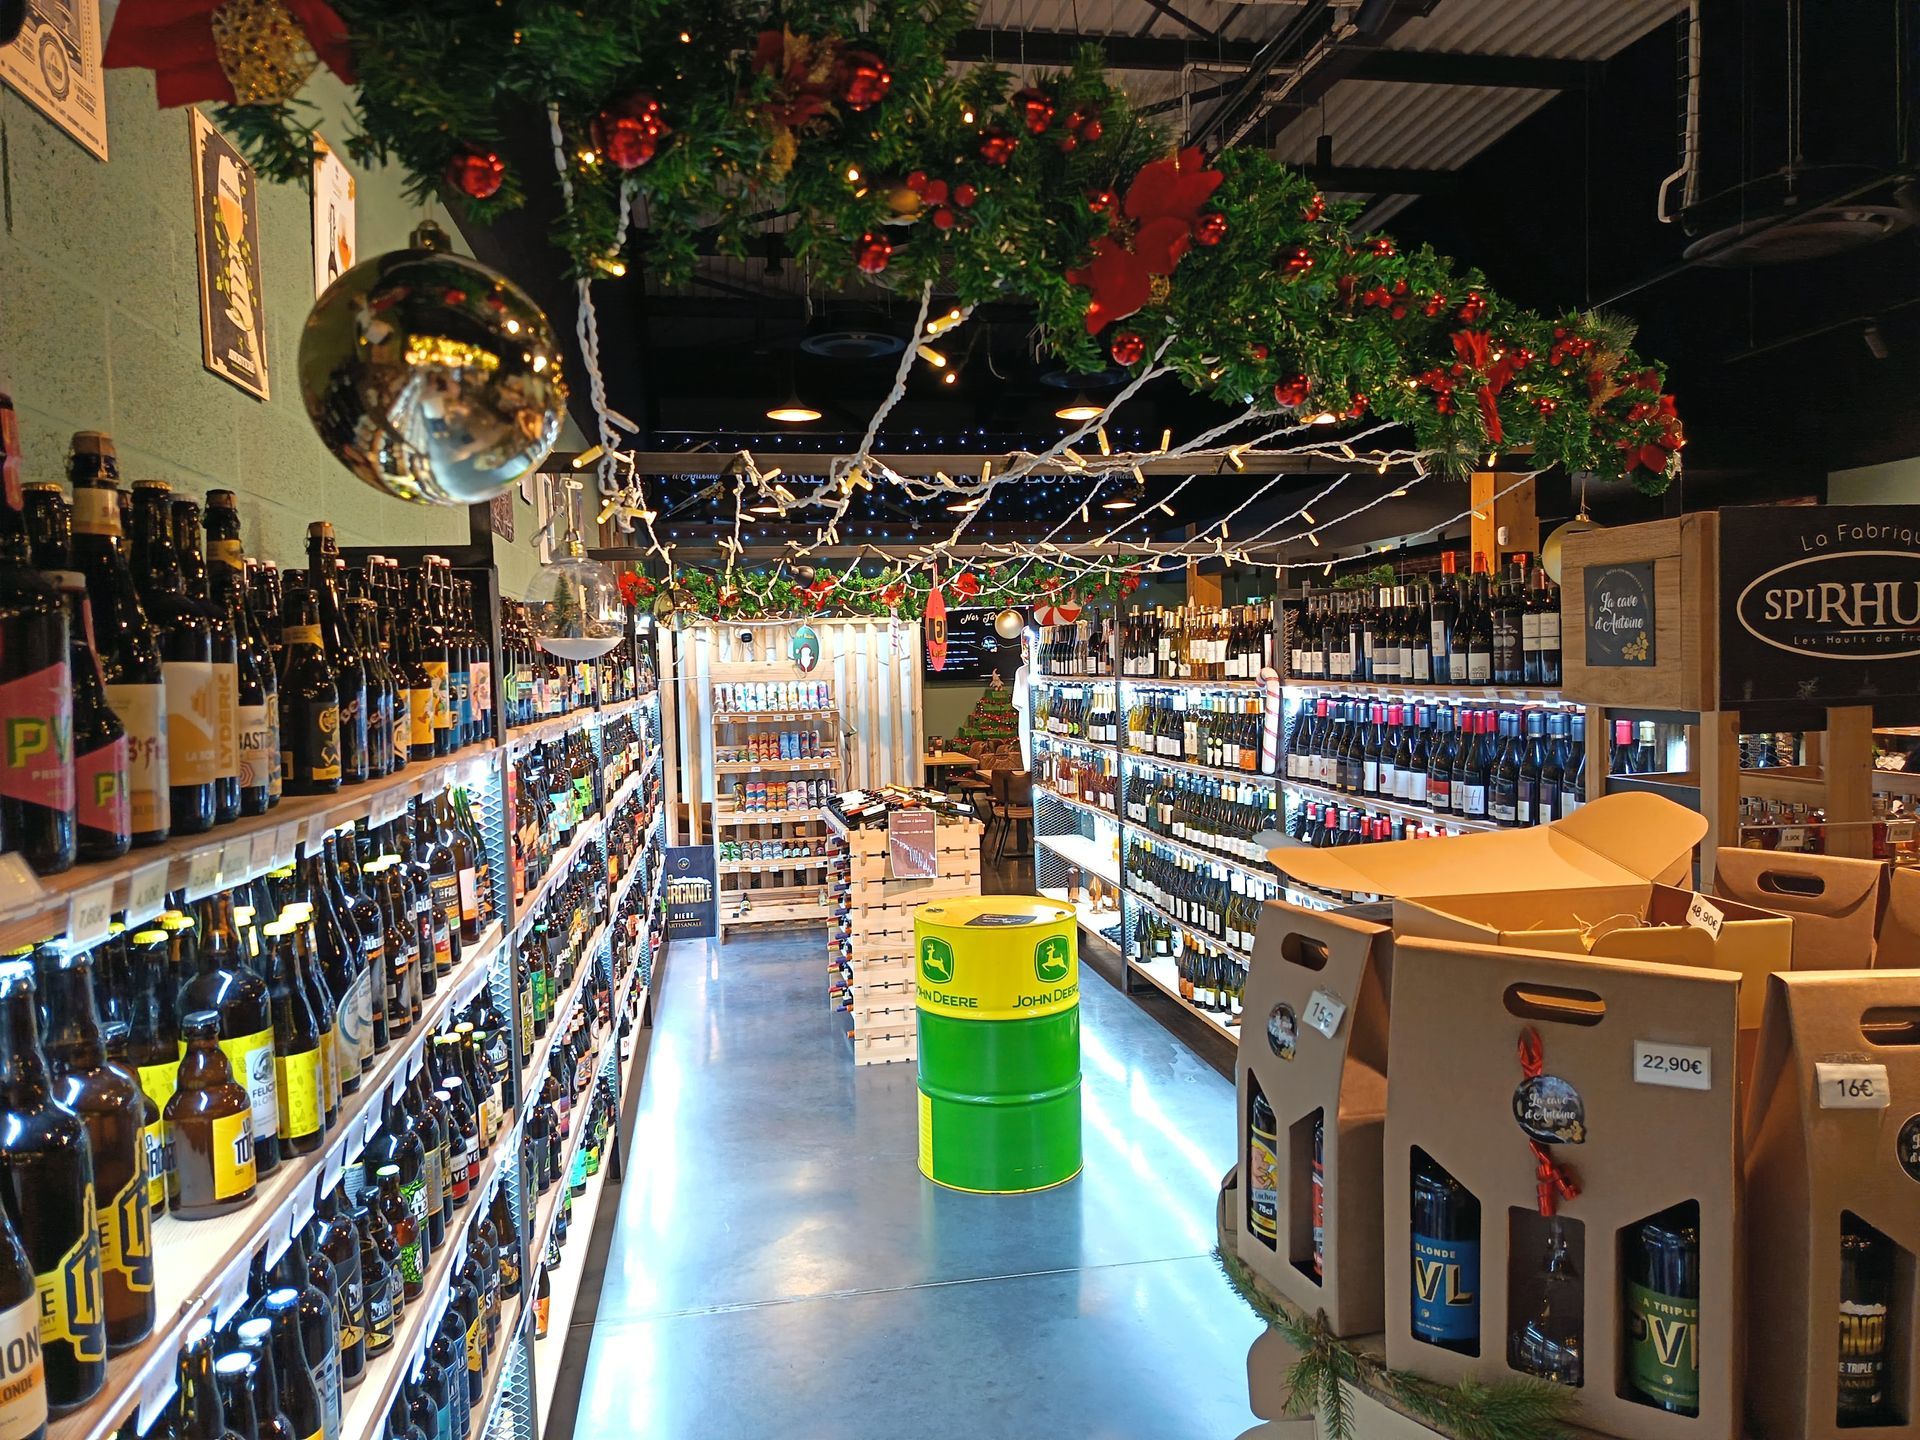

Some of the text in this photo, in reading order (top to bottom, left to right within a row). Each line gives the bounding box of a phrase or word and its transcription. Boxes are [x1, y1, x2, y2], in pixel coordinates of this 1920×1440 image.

[1801, 533, 1828, 551] La
[1599, 591, 1638, 615] La cave
[1594, 612, 1643, 635] d'Antoine
[1793, 636, 1816, 645] Les
[1826, 635, 1866, 644] Hauts
[1876, 634, 1890, 643] de
[1692, 904, 1718, 930] 48,90€
[933, 991, 978, 1008] DEERE
[1012, 993, 1052, 1009] JOHN
[1642, 1053, 1703, 1076] 22,90€
[1837, 1078, 1874, 1098] 16€
[1415, 1243, 1457, 1259] BLONDE
[1847, 1362, 1873, 1373] TRIPLE
